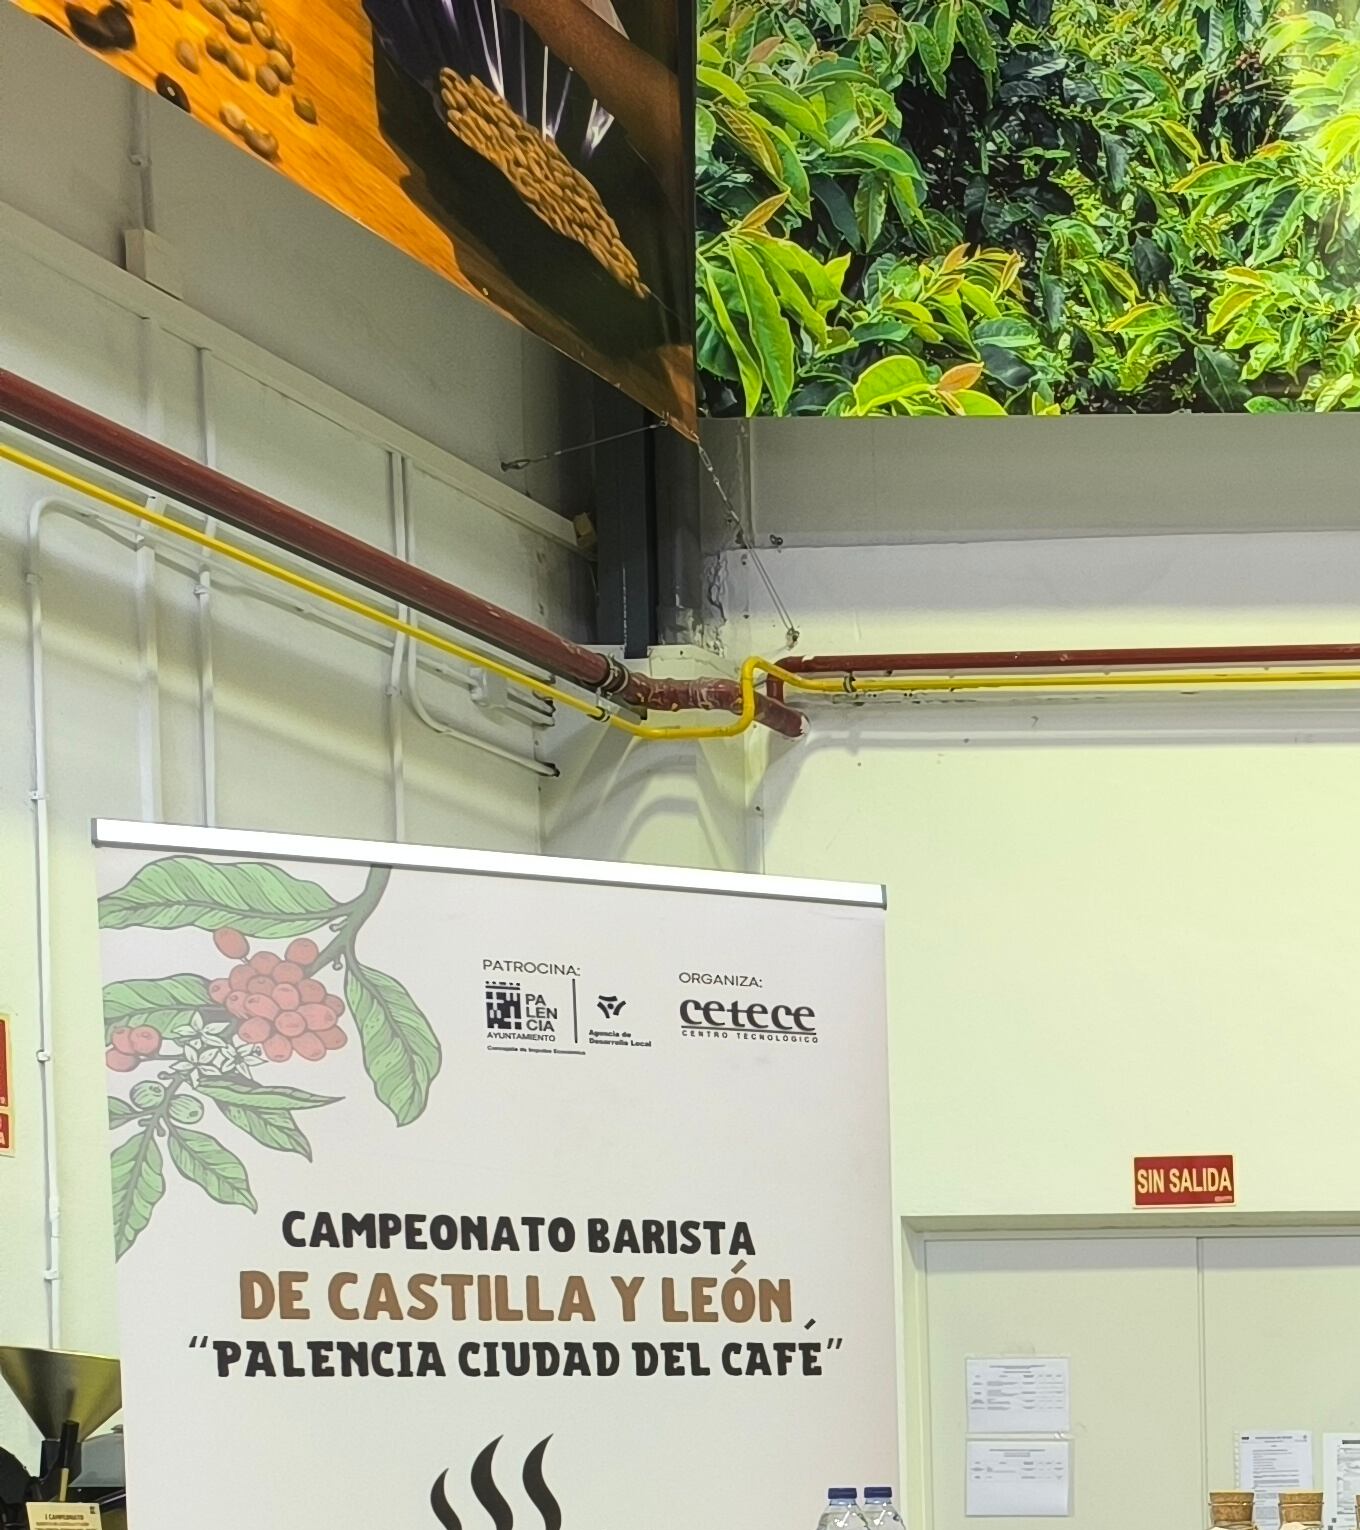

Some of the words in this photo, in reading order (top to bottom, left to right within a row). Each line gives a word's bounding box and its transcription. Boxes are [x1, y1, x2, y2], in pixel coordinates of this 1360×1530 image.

[482, 960, 581, 976] PATROCINA:
[679, 972, 763, 988] ORGANIZA:
[525, 994, 546, 1006] PA
[525, 1006, 558, 1019] LEN
[680, 999, 816, 1031] cetece
[525, 1019, 555, 1032] CIA
[487, 1032, 556, 1042] AYUNTAMIENTO
[682, 1030, 728, 1039] CENTRO
[737, 1032, 819, 1043] TECNOLÓGICO
[1137, 1169, 1165, 1194] SIN
[1169, 1167, 1232, 1193] SALIDA
[282, 1211, 576, 1254] CAMPEONATO
[588, 1218, 756, 1257] BARISTA
[239, 1270, 311, 1321] DE
[328, 1272, 597, 1323] CASTILLA
[612, 1276, 647, 1323] Y
[661, 1259, 793, 1324] LEÓN
[188, 1336, 447, 1379] "PALENCIA
[458, 1341, 620, 1378] CIUDAD
[631, 1341, 711, 1378] DEL
